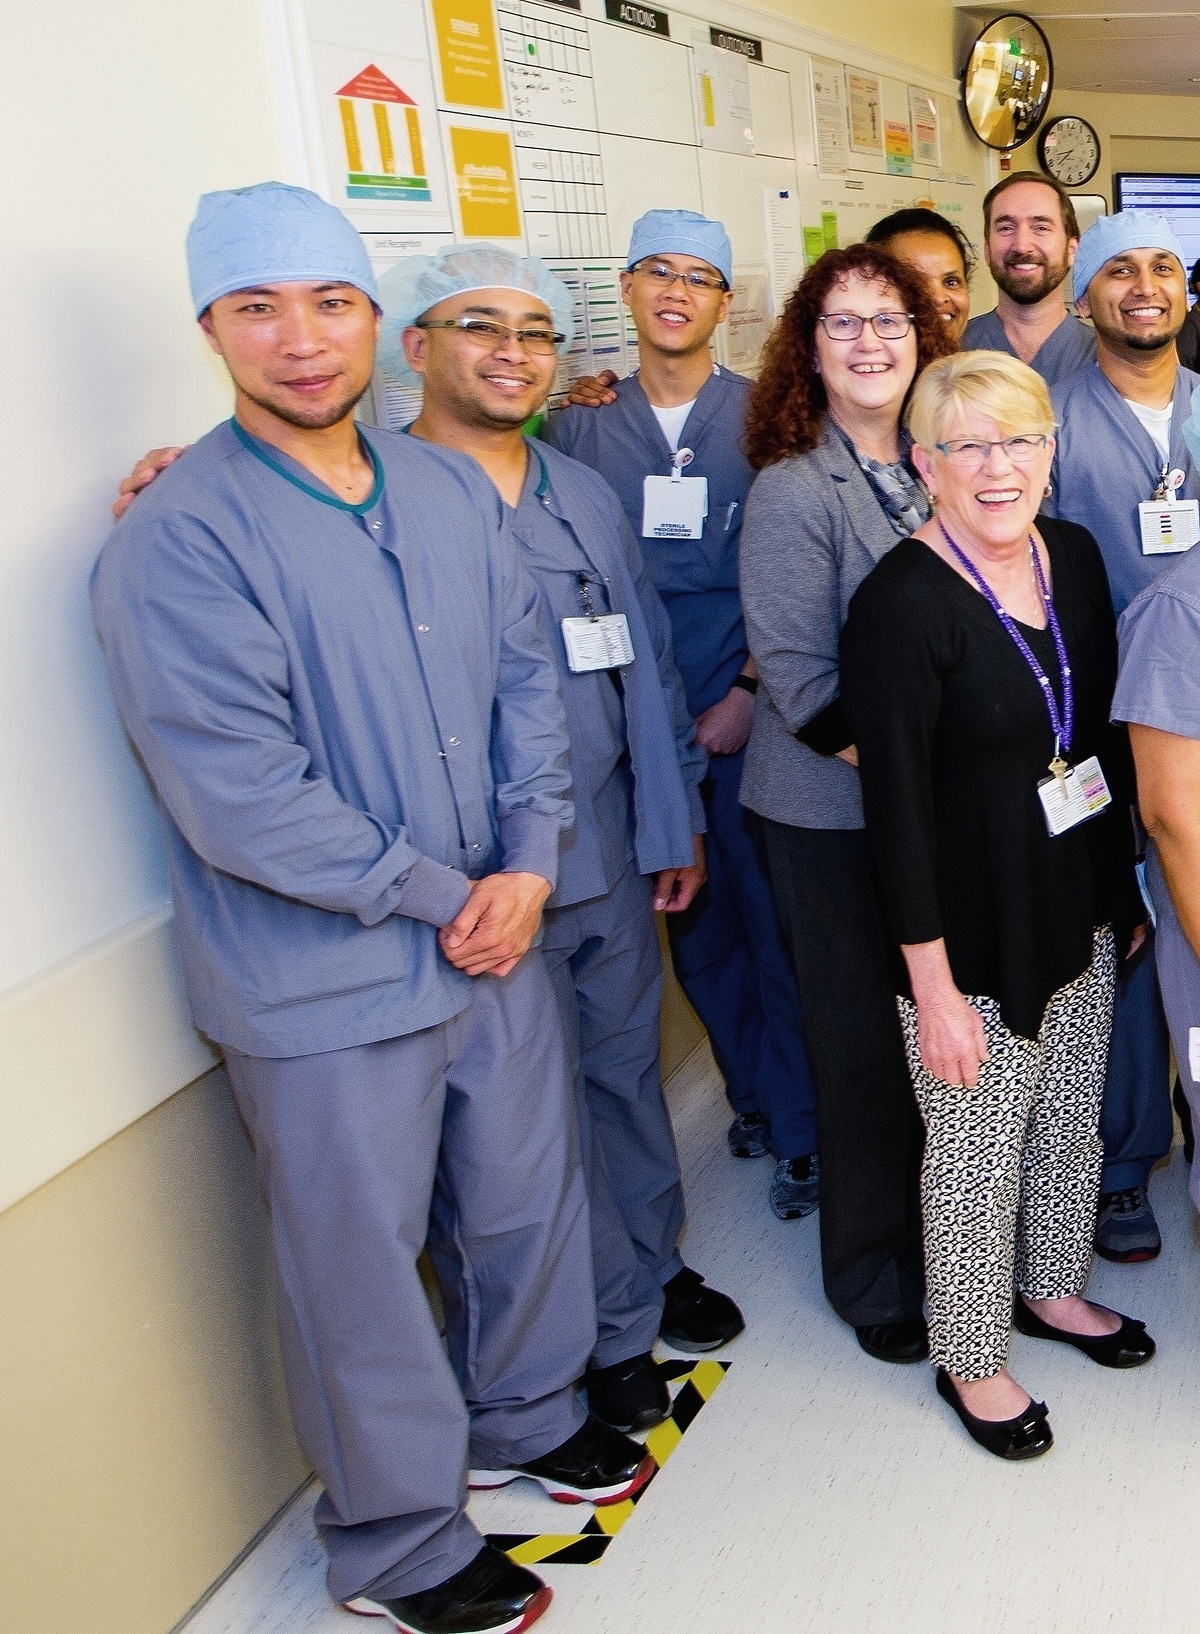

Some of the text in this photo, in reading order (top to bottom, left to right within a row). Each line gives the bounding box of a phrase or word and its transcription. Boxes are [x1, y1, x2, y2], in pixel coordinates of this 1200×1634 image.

[620, 4, 656, 29] ACTIONS
[718, 34, 756, 56] OUTCOMES
[1066, 120, 1076, 130] 12
[1086, 135, 1092, 144] 2
[1085, 162, 1090, 170] 4
[1066, 174, 1072, 182] 6
[1078, 172, 1083, 180] 5
